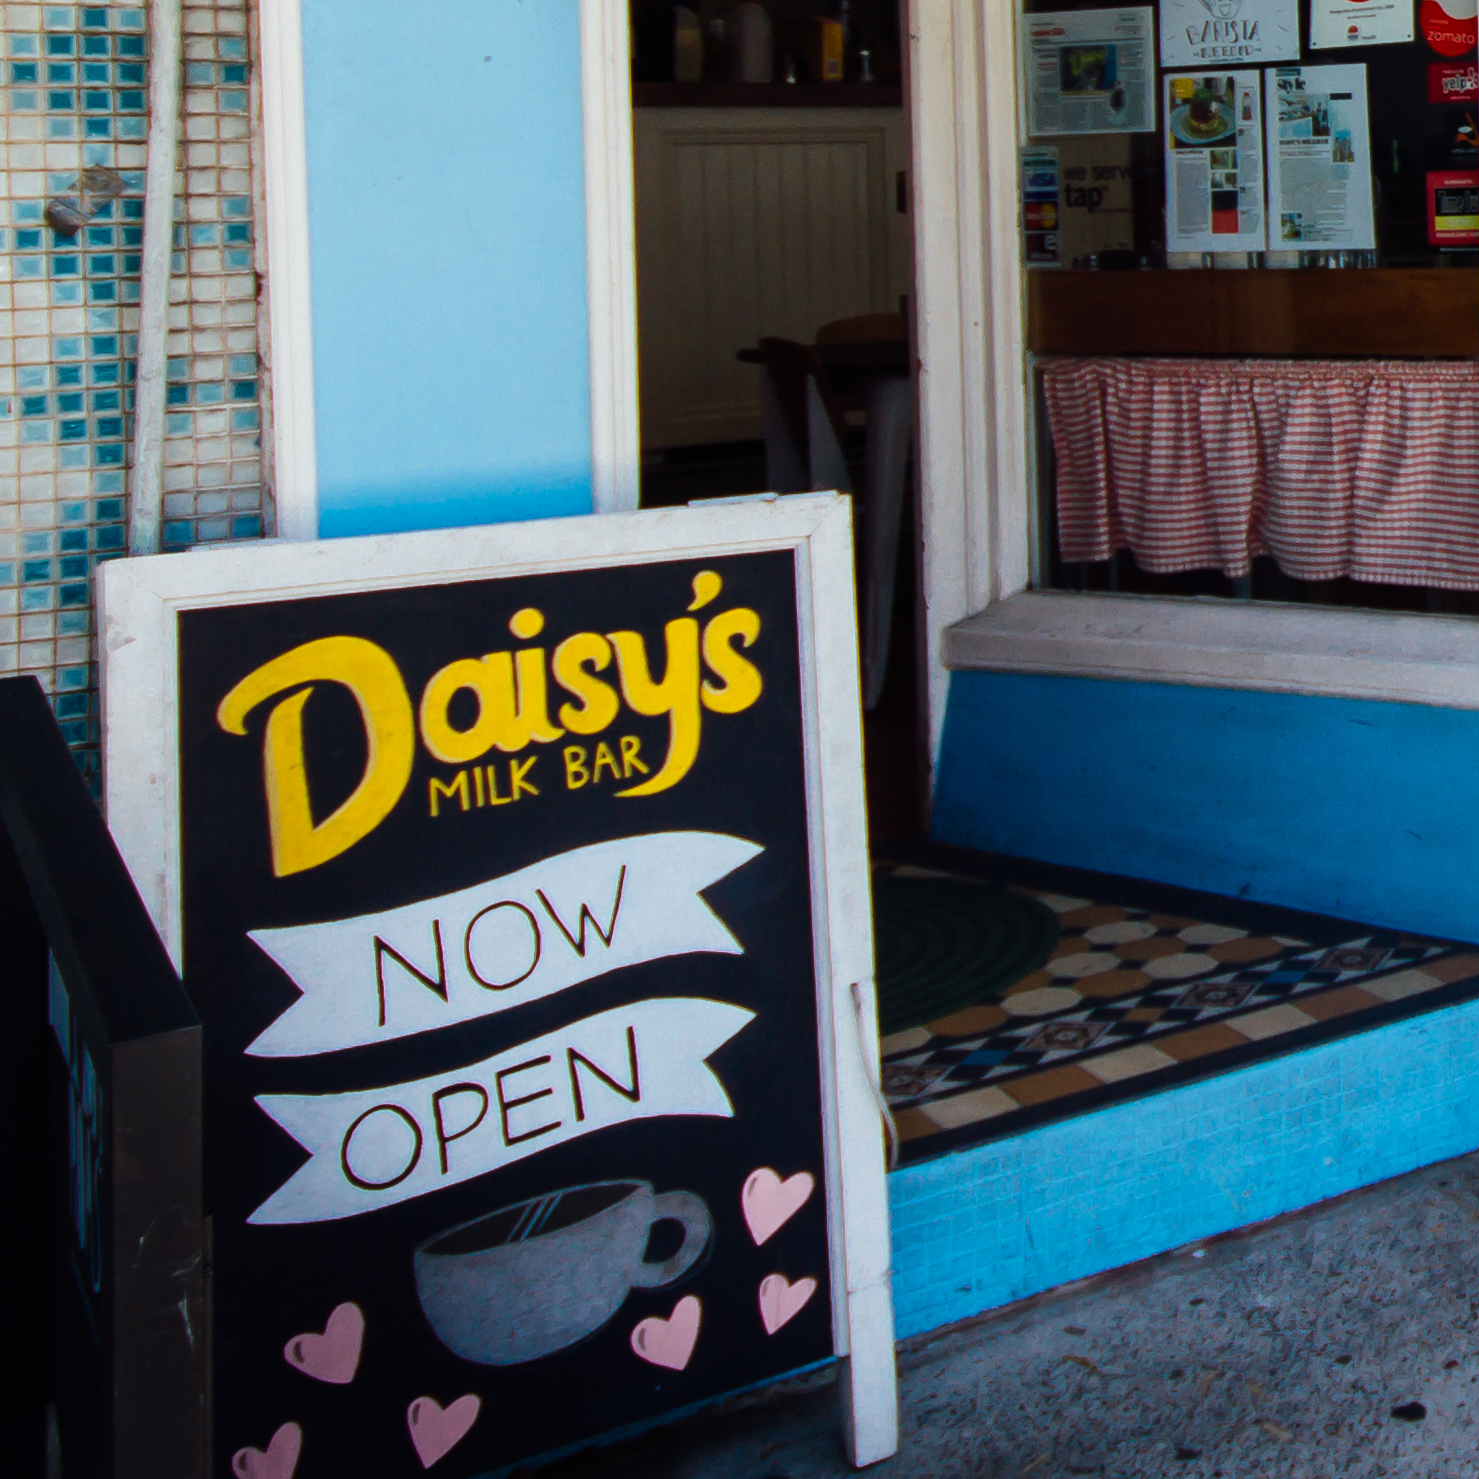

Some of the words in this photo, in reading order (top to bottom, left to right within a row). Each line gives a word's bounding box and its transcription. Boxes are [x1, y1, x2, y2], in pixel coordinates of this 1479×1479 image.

[1427, 30, 1475, 44] zomato
[1441, 73, 1470, 94] yelp
[1064, 183, 1103, 213] tap
[216, 569, 764, 878] Daisy's
[428, 754, 540, 818] MILK
[565, 734, 650, 791] BAR
[372, 864, 628, 1027] NOW
[340, 1025, 640, 1192] OPEN
